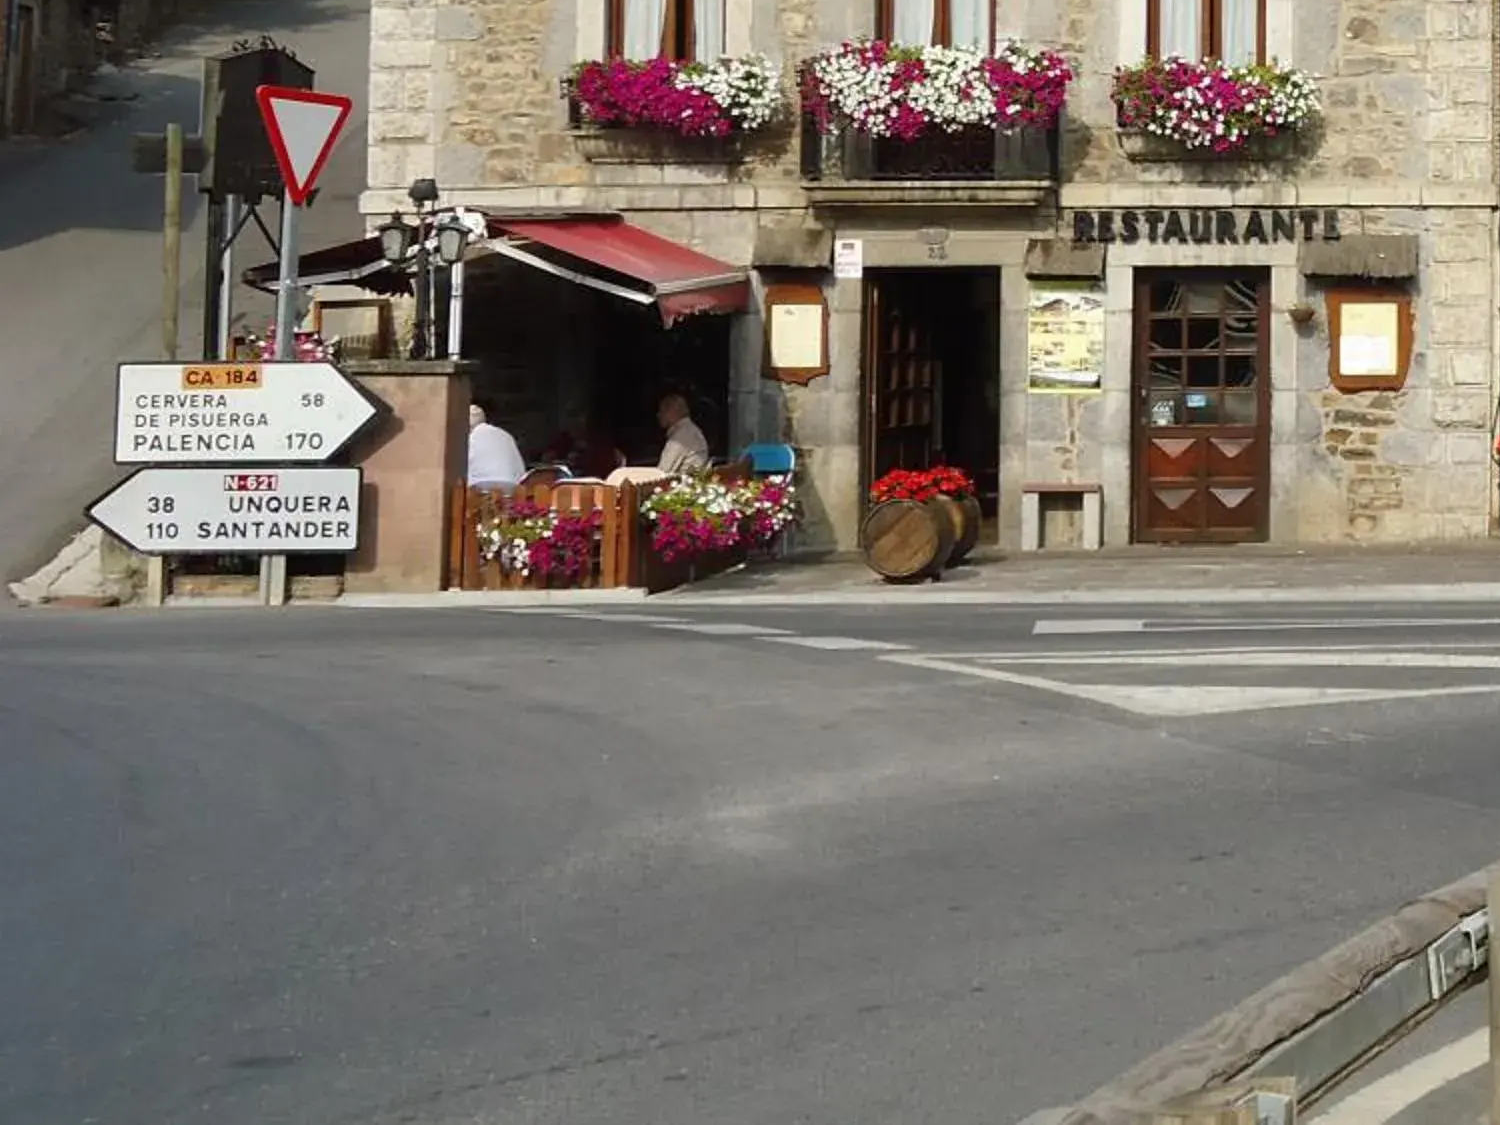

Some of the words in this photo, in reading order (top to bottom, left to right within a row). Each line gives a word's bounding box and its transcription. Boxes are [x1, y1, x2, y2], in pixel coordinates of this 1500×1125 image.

[1072, 210, 1341, 244] RESTAURANTE
[185, 370, 213, 385] CA
[226, 370, 258, 384] 184
[135, 394, 227, 409] CERVERA
[301, 393, 324, 408] 58
[135, 414, 160, 428] DE
[169, 412, 269, 427] PISUERGA
[133, 434, 255, 452] PALENCIA
[285, 433, 323, 450] 170
[225, 476, 277, 491] N-621
[147, 497, 175, 514] 38
[229, 496, 350, 514] UNQUERA
[146, 522, 179, 539] 110
[197, 522, 350, 538] SANTANDER
